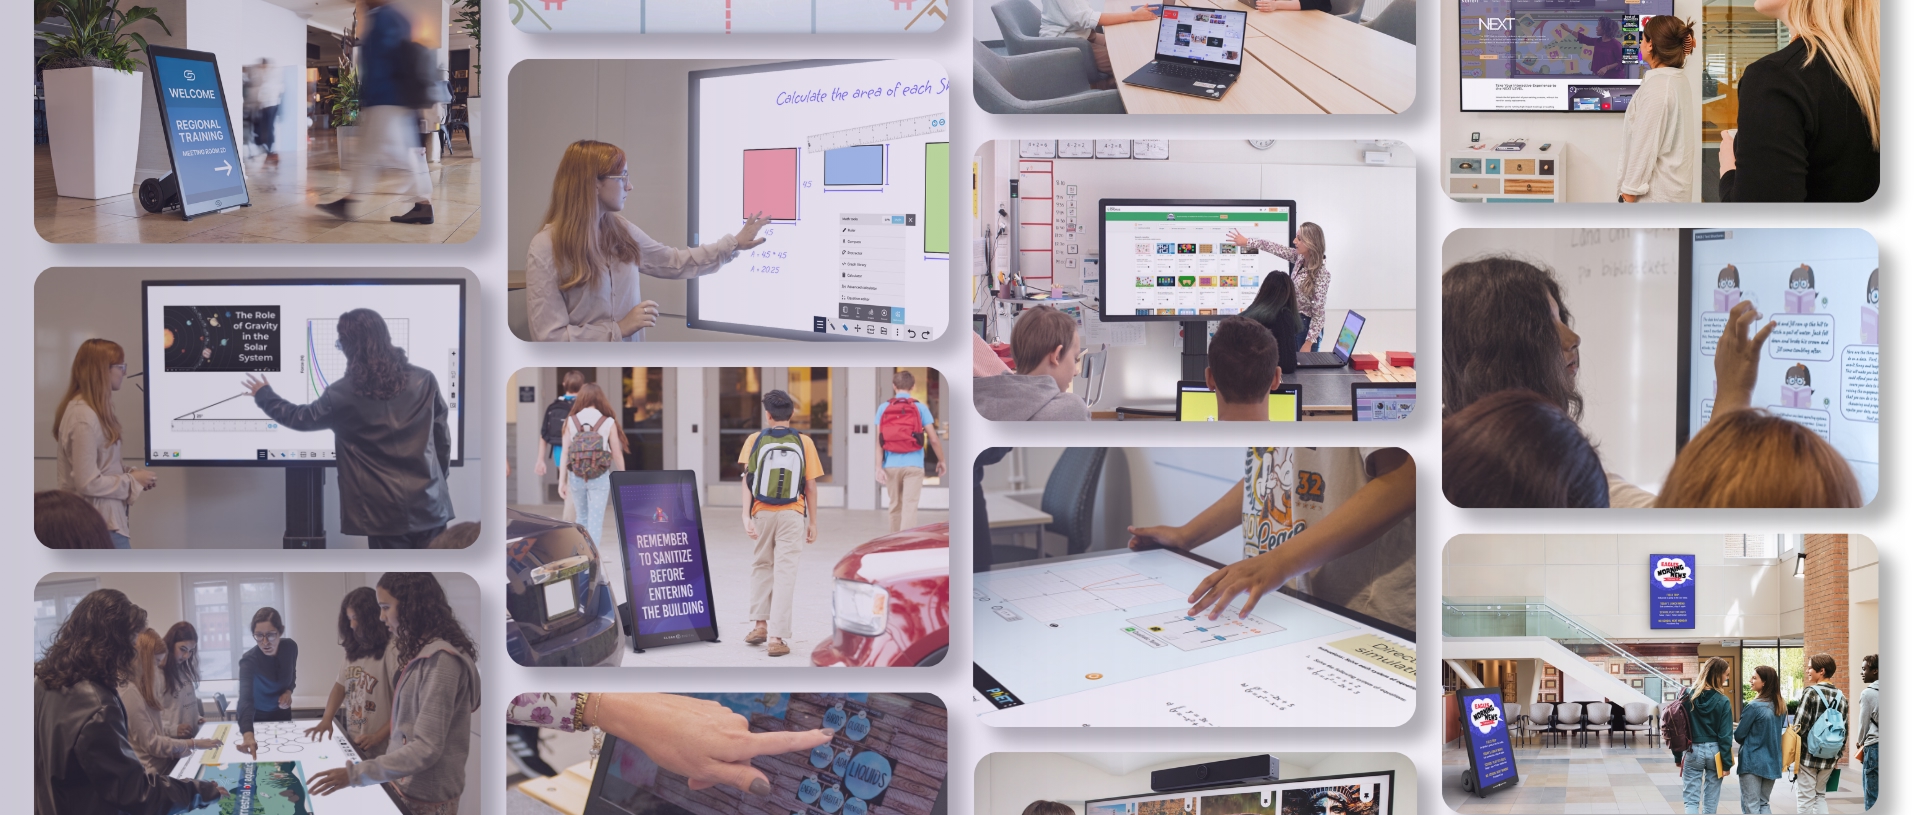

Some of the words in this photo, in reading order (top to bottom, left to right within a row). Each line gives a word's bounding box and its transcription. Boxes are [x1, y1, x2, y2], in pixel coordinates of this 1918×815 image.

[1479, 18, 1515, 30] NEXT
[168, 88, 216, 99] WELCOME
[776, 89, 827, 106] Calculate
[831, 87, 848, 101] the
[852, 87, 882, 99] area
[886, 82, 901, 97] of
[902, 80, 932, 96] each
[176, 120, 222, 130] REGIONAL
[178, 131, 224, 142] TRAINING
[182, 148, 205, 156] MEETING
[235, 311, 252, 319] The
[255, 311, 276, 319] Role
[233, 322, 243, 330] of
[244, 322, 278, 331] Gravity
[242, 332, 251, 340] in
[253, 332, 269, 340] the
[238, 354, 273, 363] System
[1296, 470, 1324, 500] 32
[636, 532, 688, 548] REMEMBER
[639, 552, 652, 566] TO
[653, 549, 693, 565] SANITIZE
[650, 568, 685, 583] BEFORE
[1657, 564, 1684, 576] MORNING
[648, 584, 693, 601] ENTERING
[642, 604, 661, 620] THE
[662, 600, 704, 617] BUILDING
[826, 712, 844, 726] BIRDS
[1473, 705, 1495, 721] MORNING
[848, 720, 868, 734] CLOUDS
[849, 762, 887, 788] LIQUIDS
[800, 784, 820, 797] ENERGY
